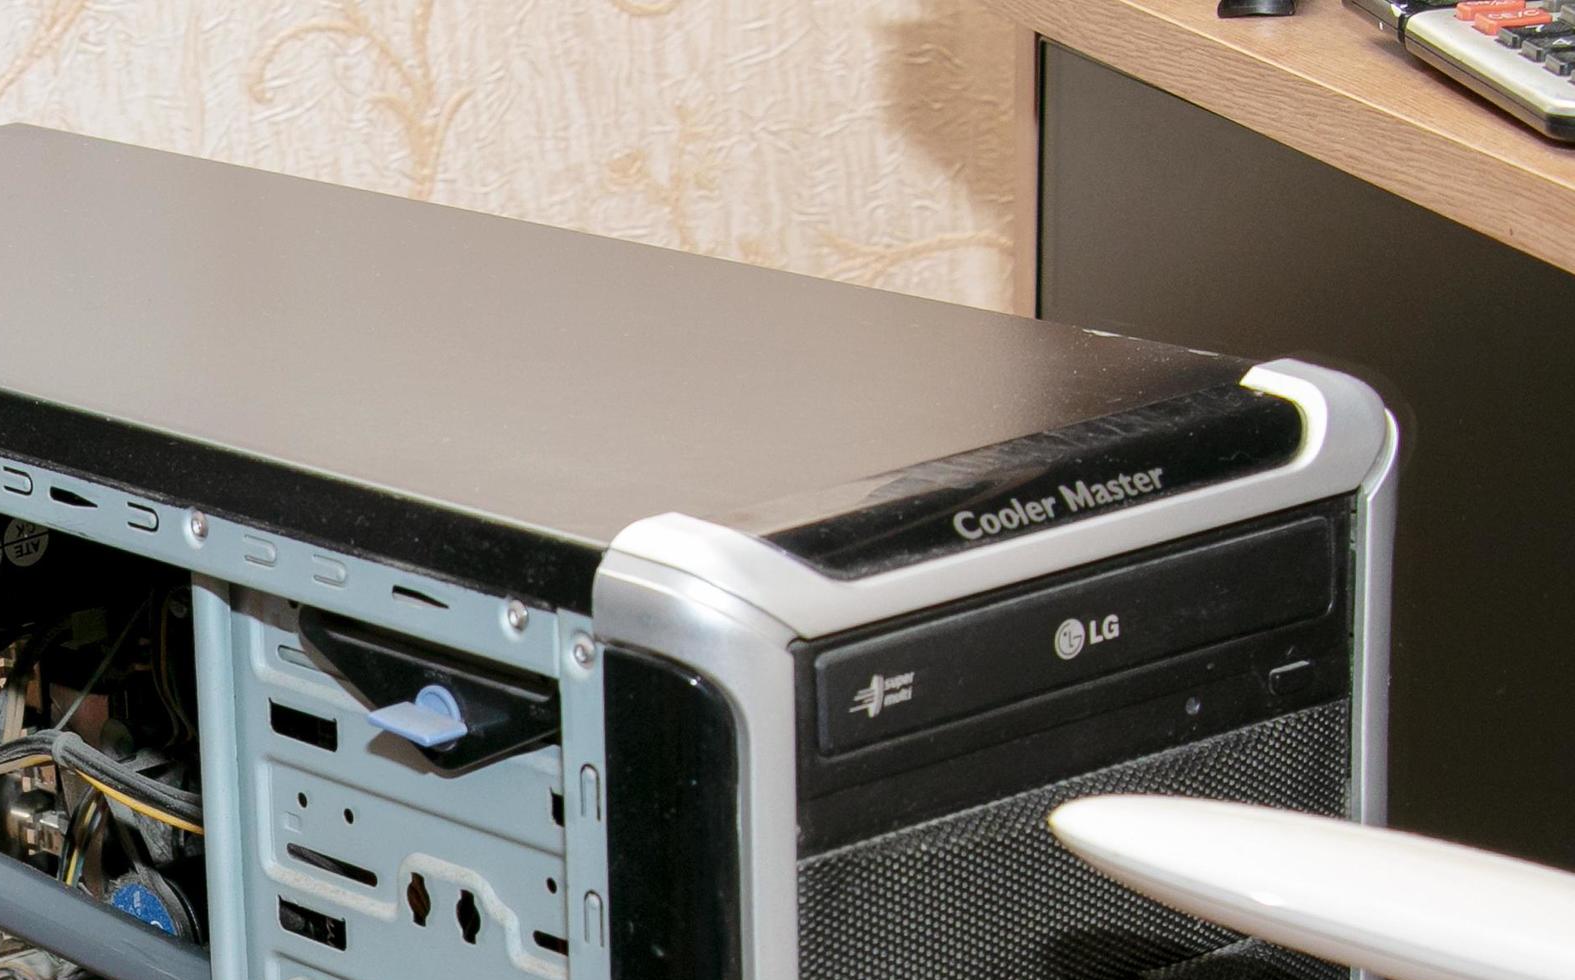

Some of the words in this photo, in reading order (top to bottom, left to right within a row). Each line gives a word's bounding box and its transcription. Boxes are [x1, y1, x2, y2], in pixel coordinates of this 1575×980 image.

[953, 496, 1057, 541] Cooler
[1058, 466, 1165, 513] Master
[13, 539, 41, 558] ATE
[1089, 614, 1120, 646] LG
